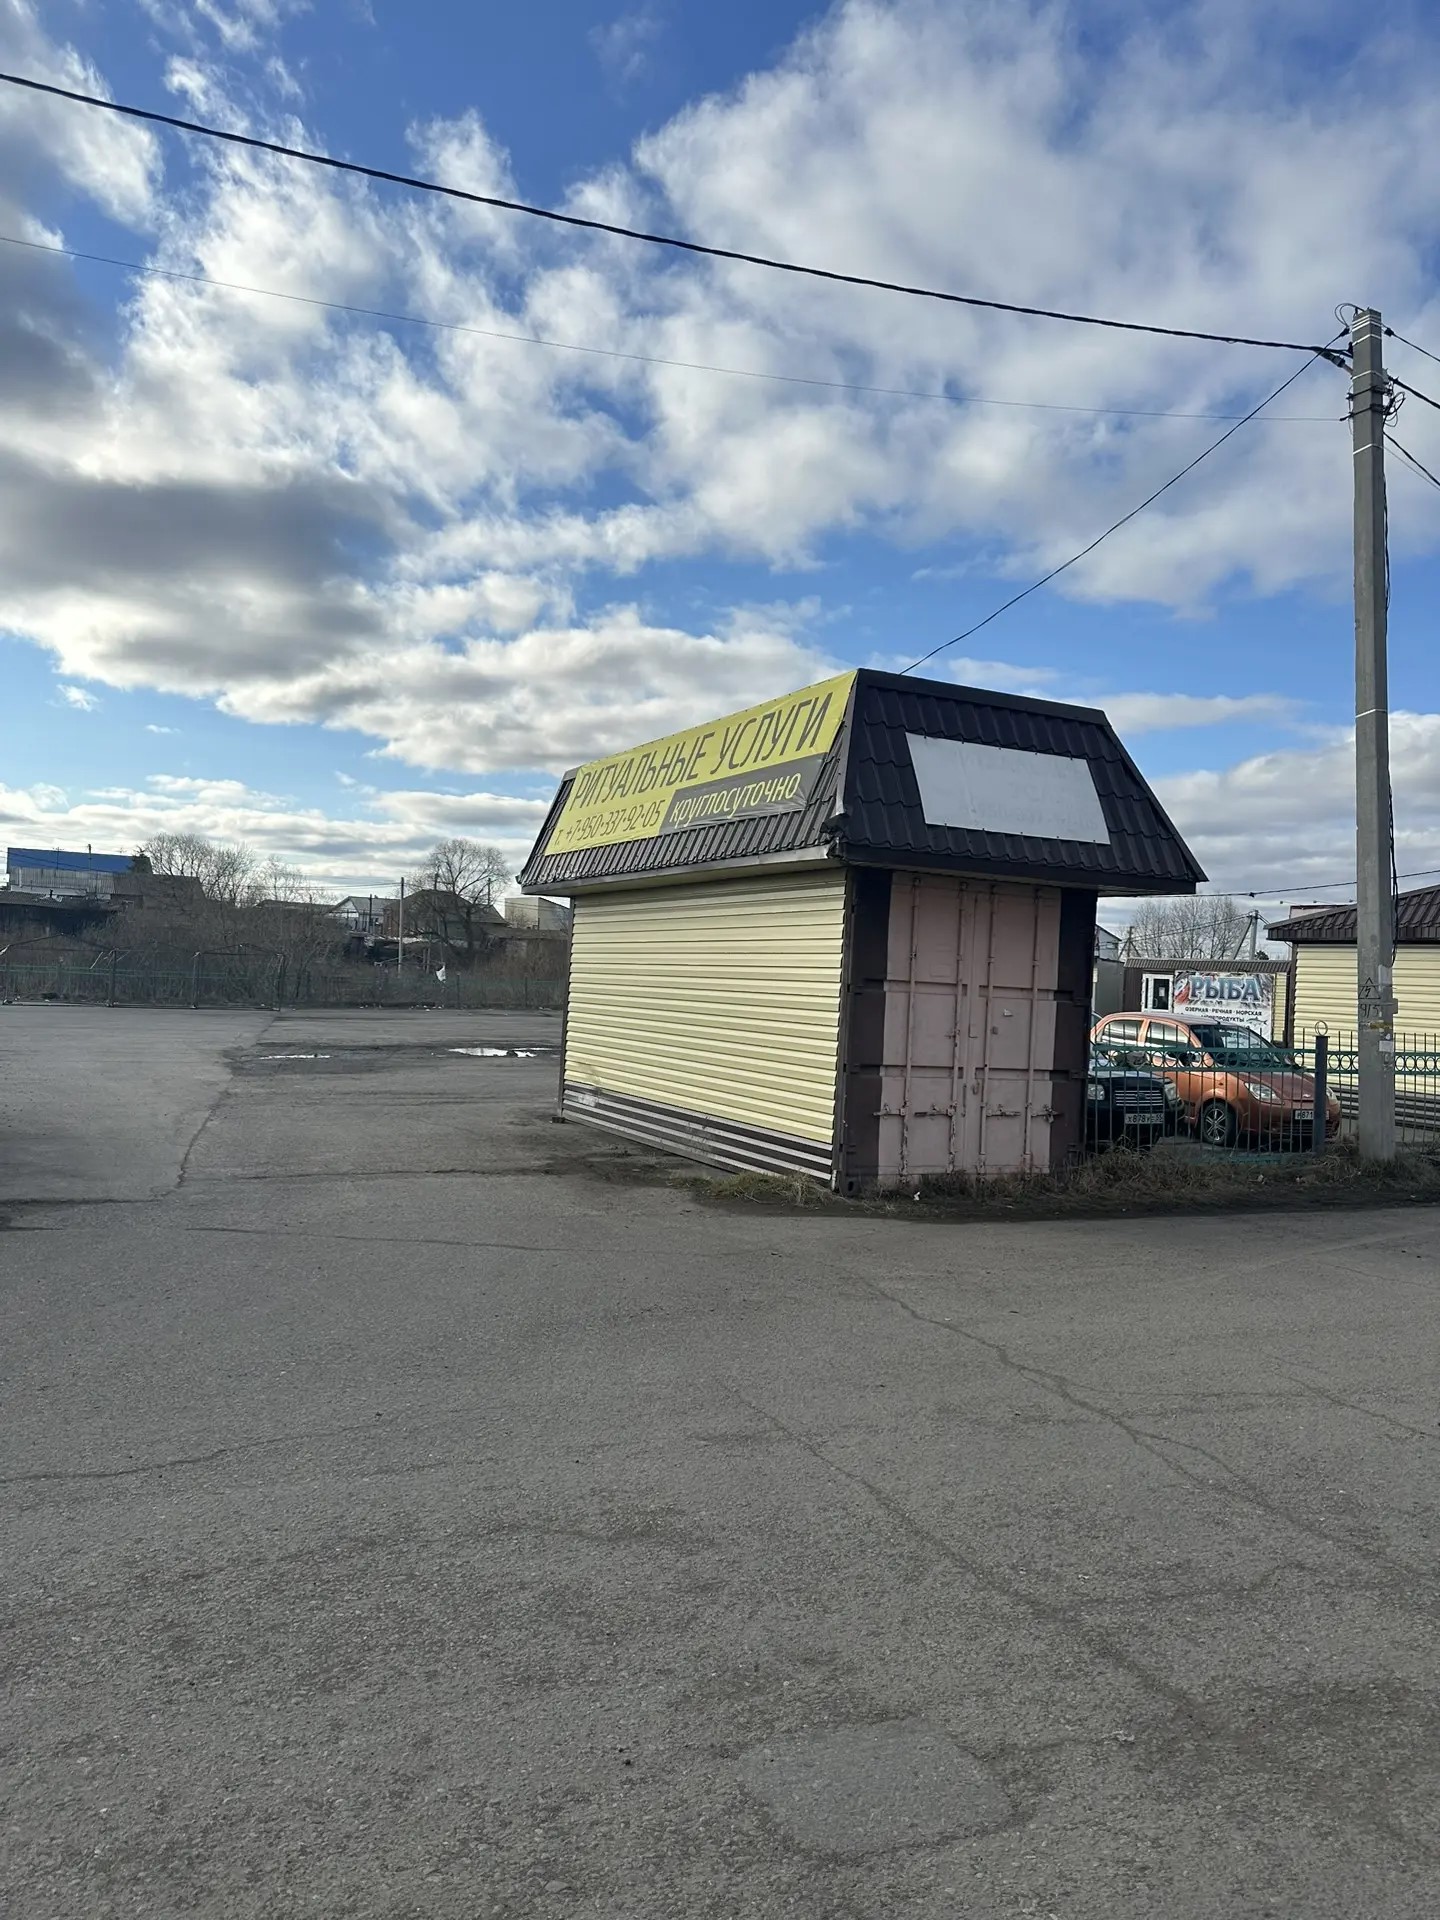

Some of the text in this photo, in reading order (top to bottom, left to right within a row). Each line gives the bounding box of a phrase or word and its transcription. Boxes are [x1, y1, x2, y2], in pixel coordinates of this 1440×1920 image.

[569, 691, 834, 812] РИТУАЛЬНЫЕ УСЛУГИ
[668, 772, 802, 829] круглосуточно
[1190, 976, 1260, 1002] РЫБА
